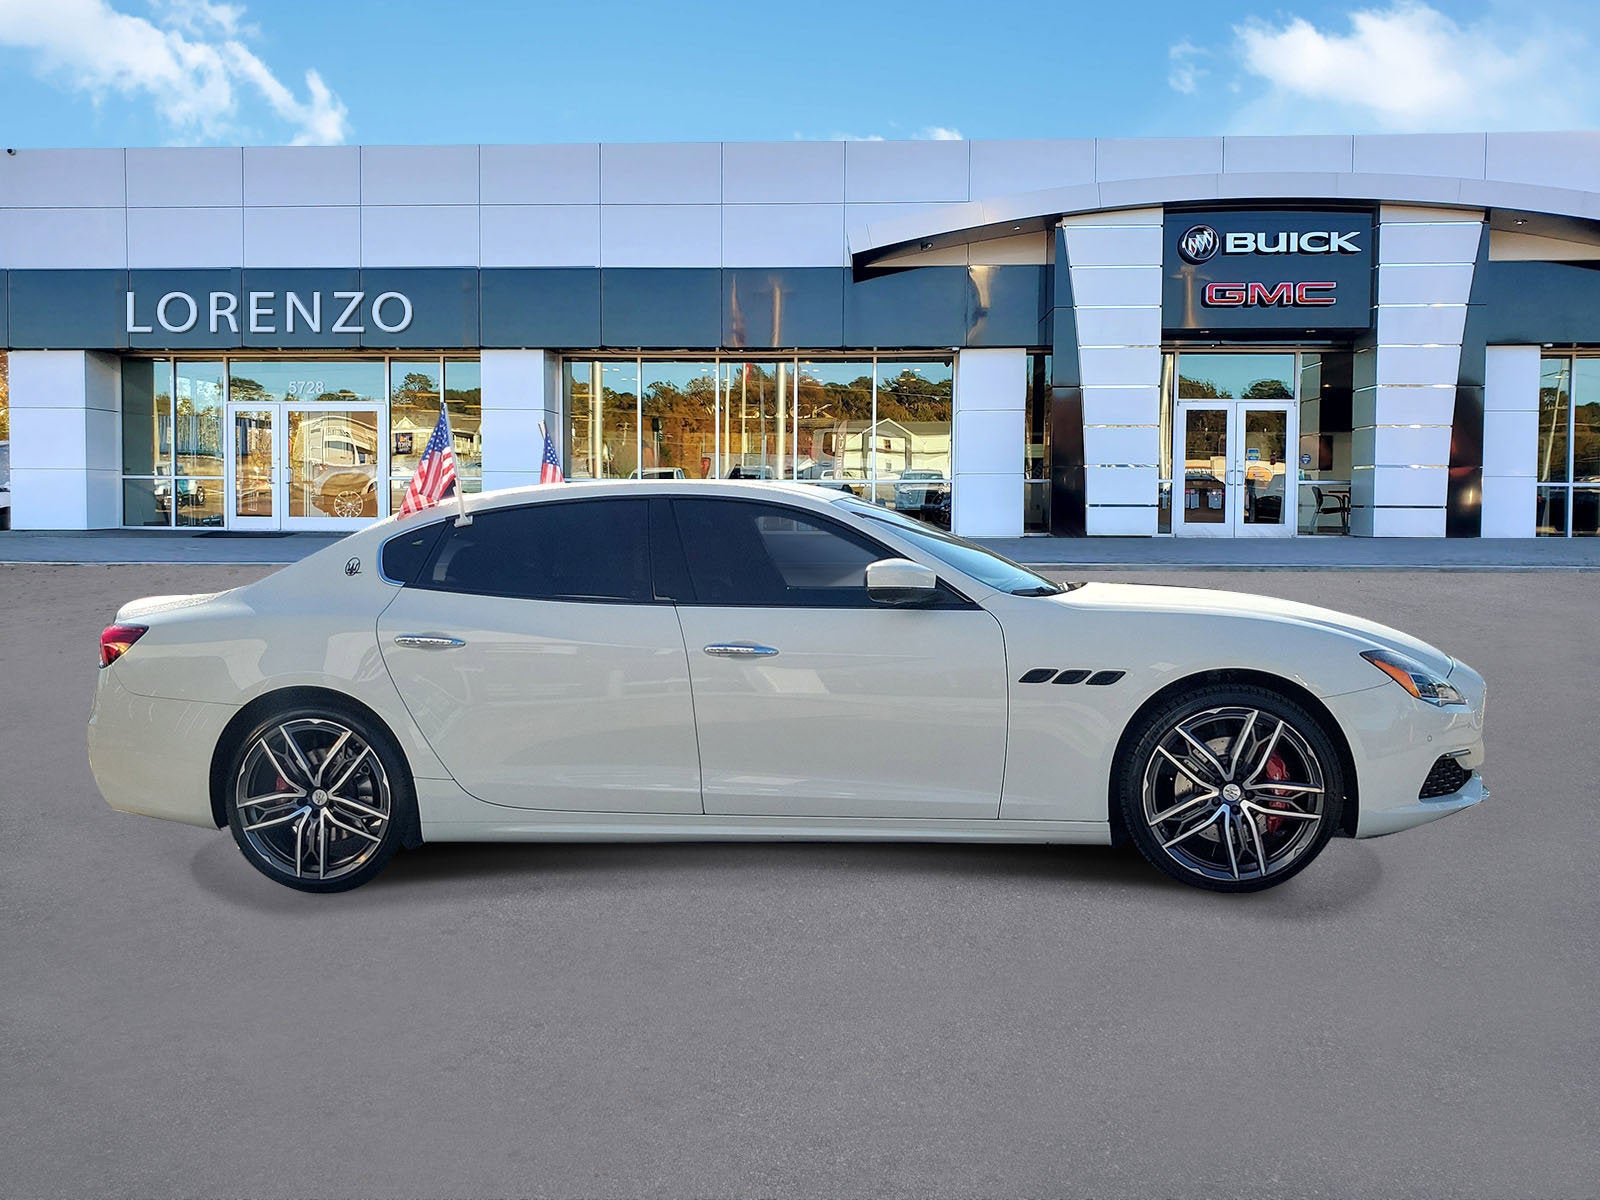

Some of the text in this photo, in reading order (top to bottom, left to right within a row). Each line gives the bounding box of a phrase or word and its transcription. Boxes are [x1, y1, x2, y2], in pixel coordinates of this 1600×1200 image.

[1226, 231, 1362, 254] BUICK
[1206, 282, 1337, 306] GMC
[126, 291, 414, 333] LORENZO
[288, 380, 325, 395] 5728
